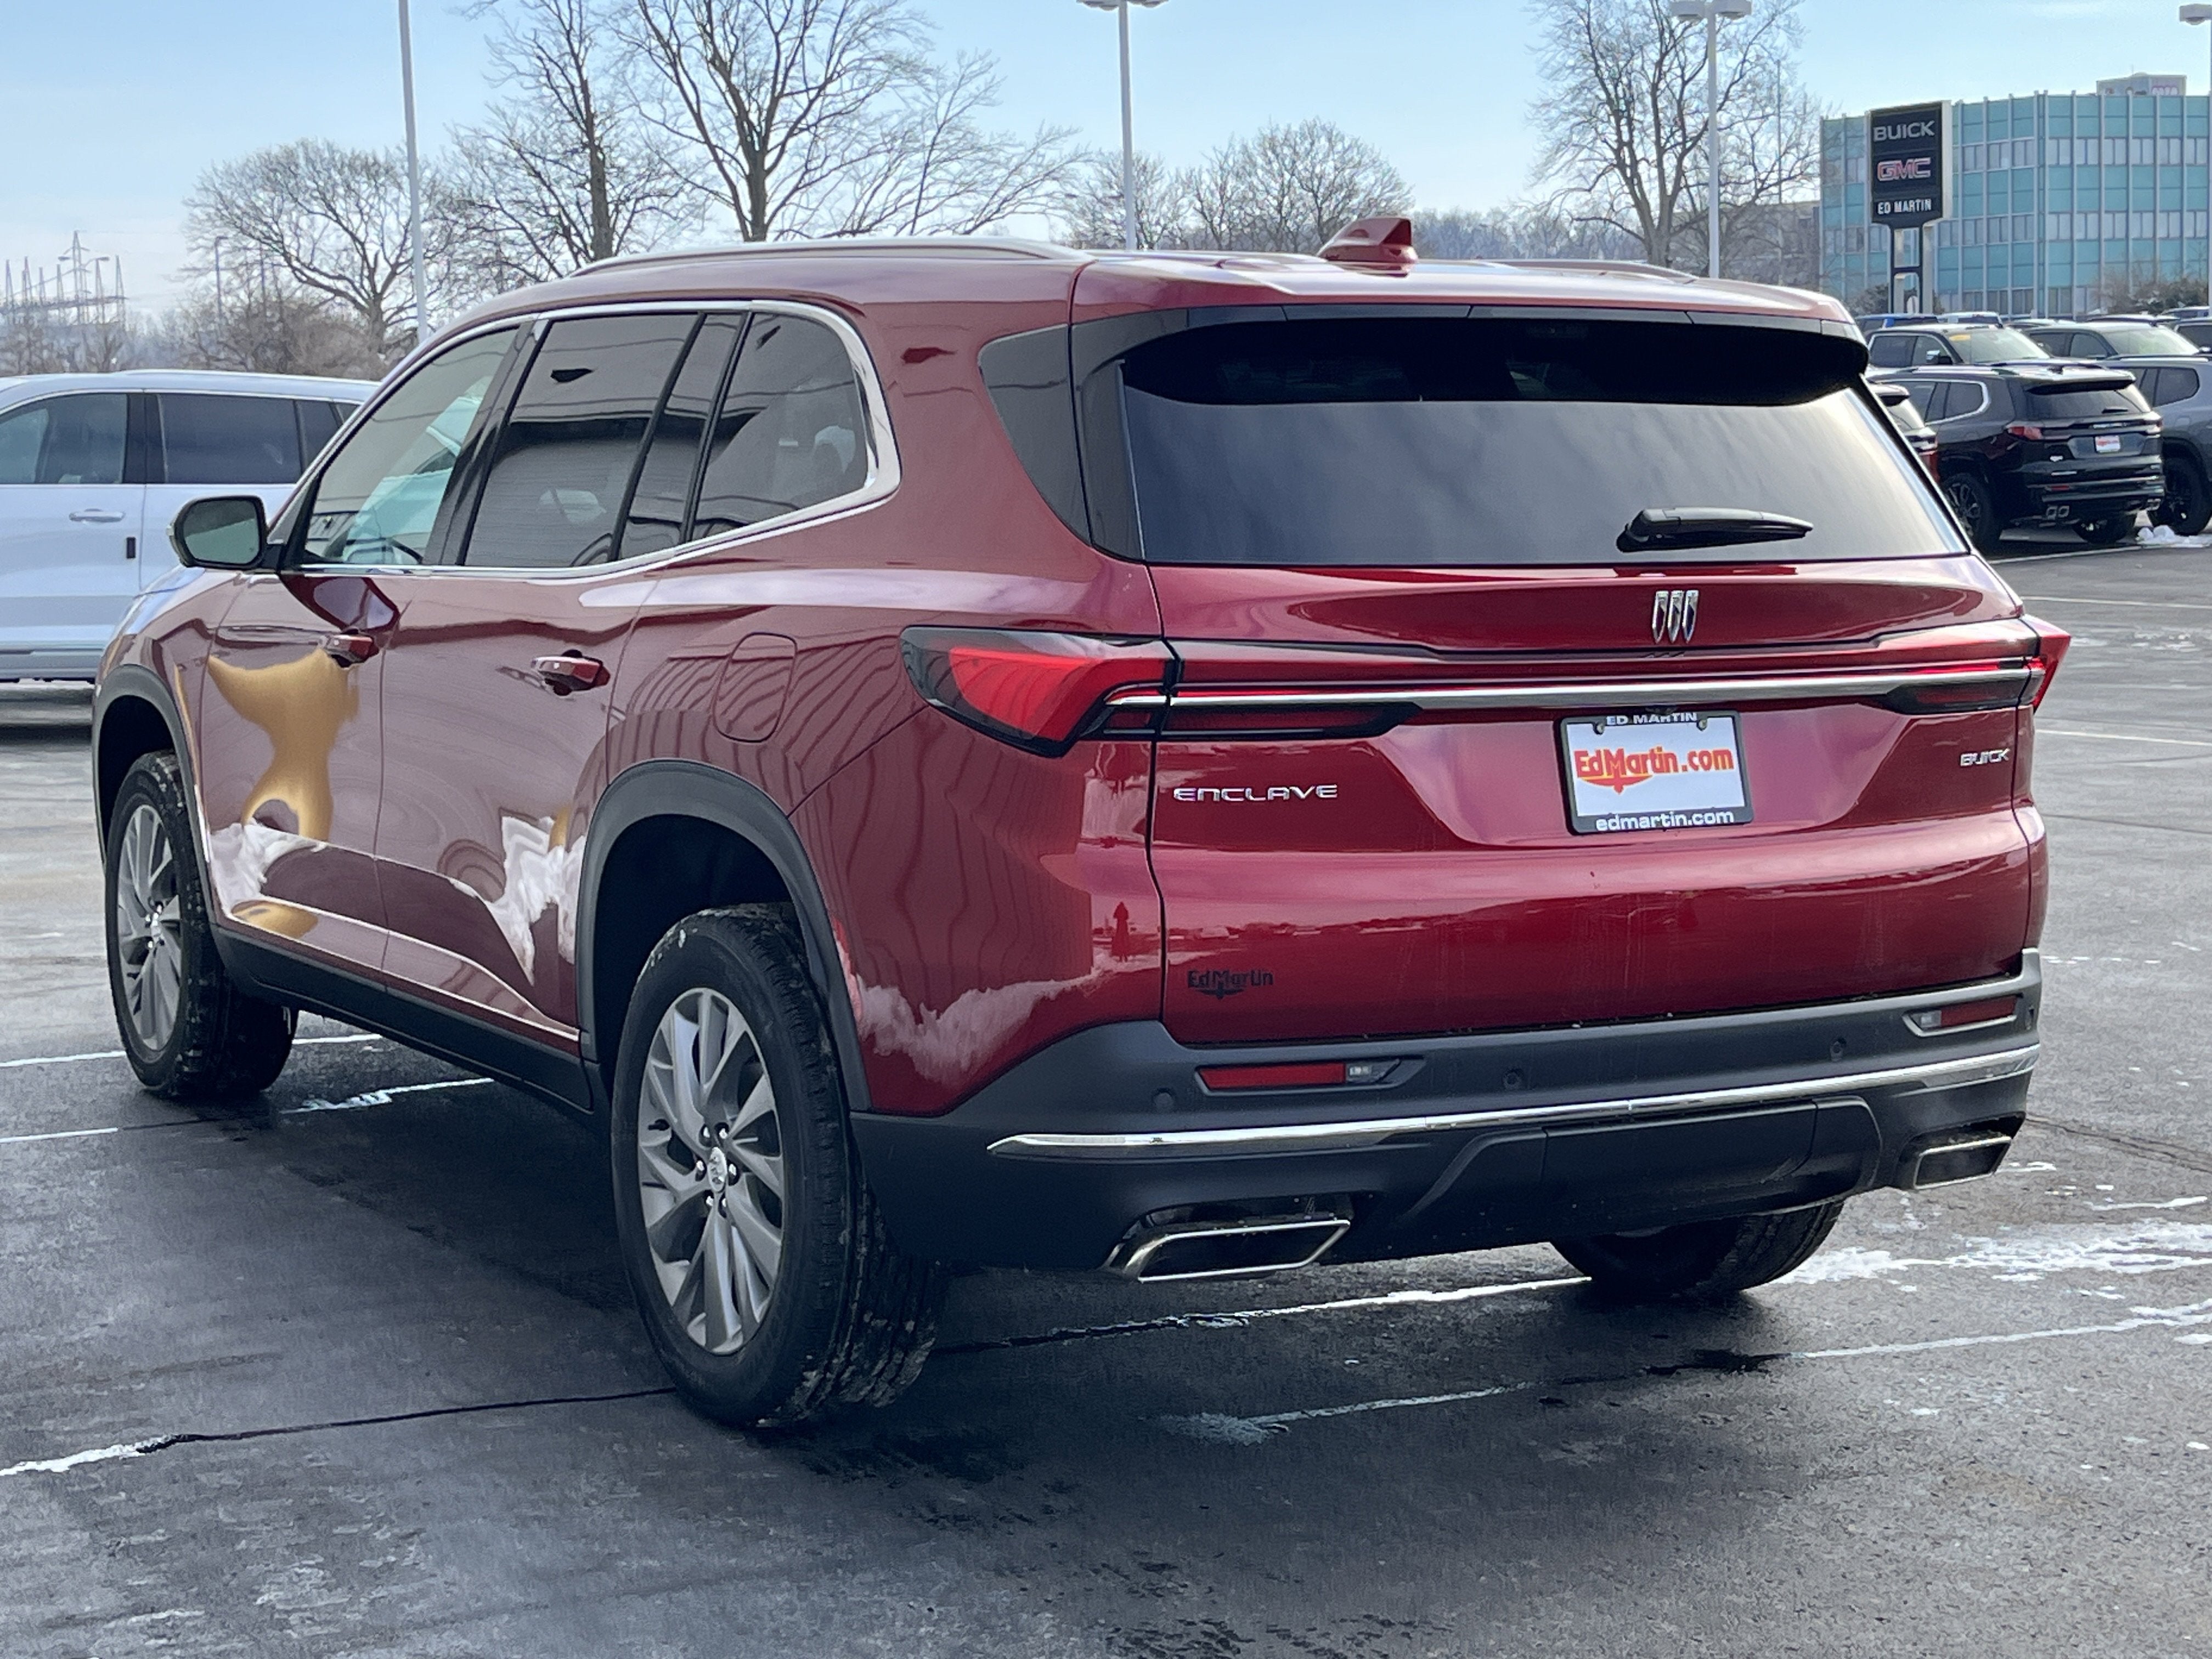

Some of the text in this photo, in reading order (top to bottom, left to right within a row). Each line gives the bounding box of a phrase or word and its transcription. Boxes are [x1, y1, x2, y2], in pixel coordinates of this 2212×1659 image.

[1873, 120, 1936, 142] BUICK
[1877, 157, 1931, 182] GMC
[1877, 198, 1932, 215] ED MARTIN
[1606, 713, 1697, 725] ED MARTIN
[1960, 748, 2010, 766] BUICK
[1173, 784, 1338, 802] ENCLAVE
[1595, 811, 1734, 832] edmartin.com
[1187, 969, 1274, 988] EdMartin
